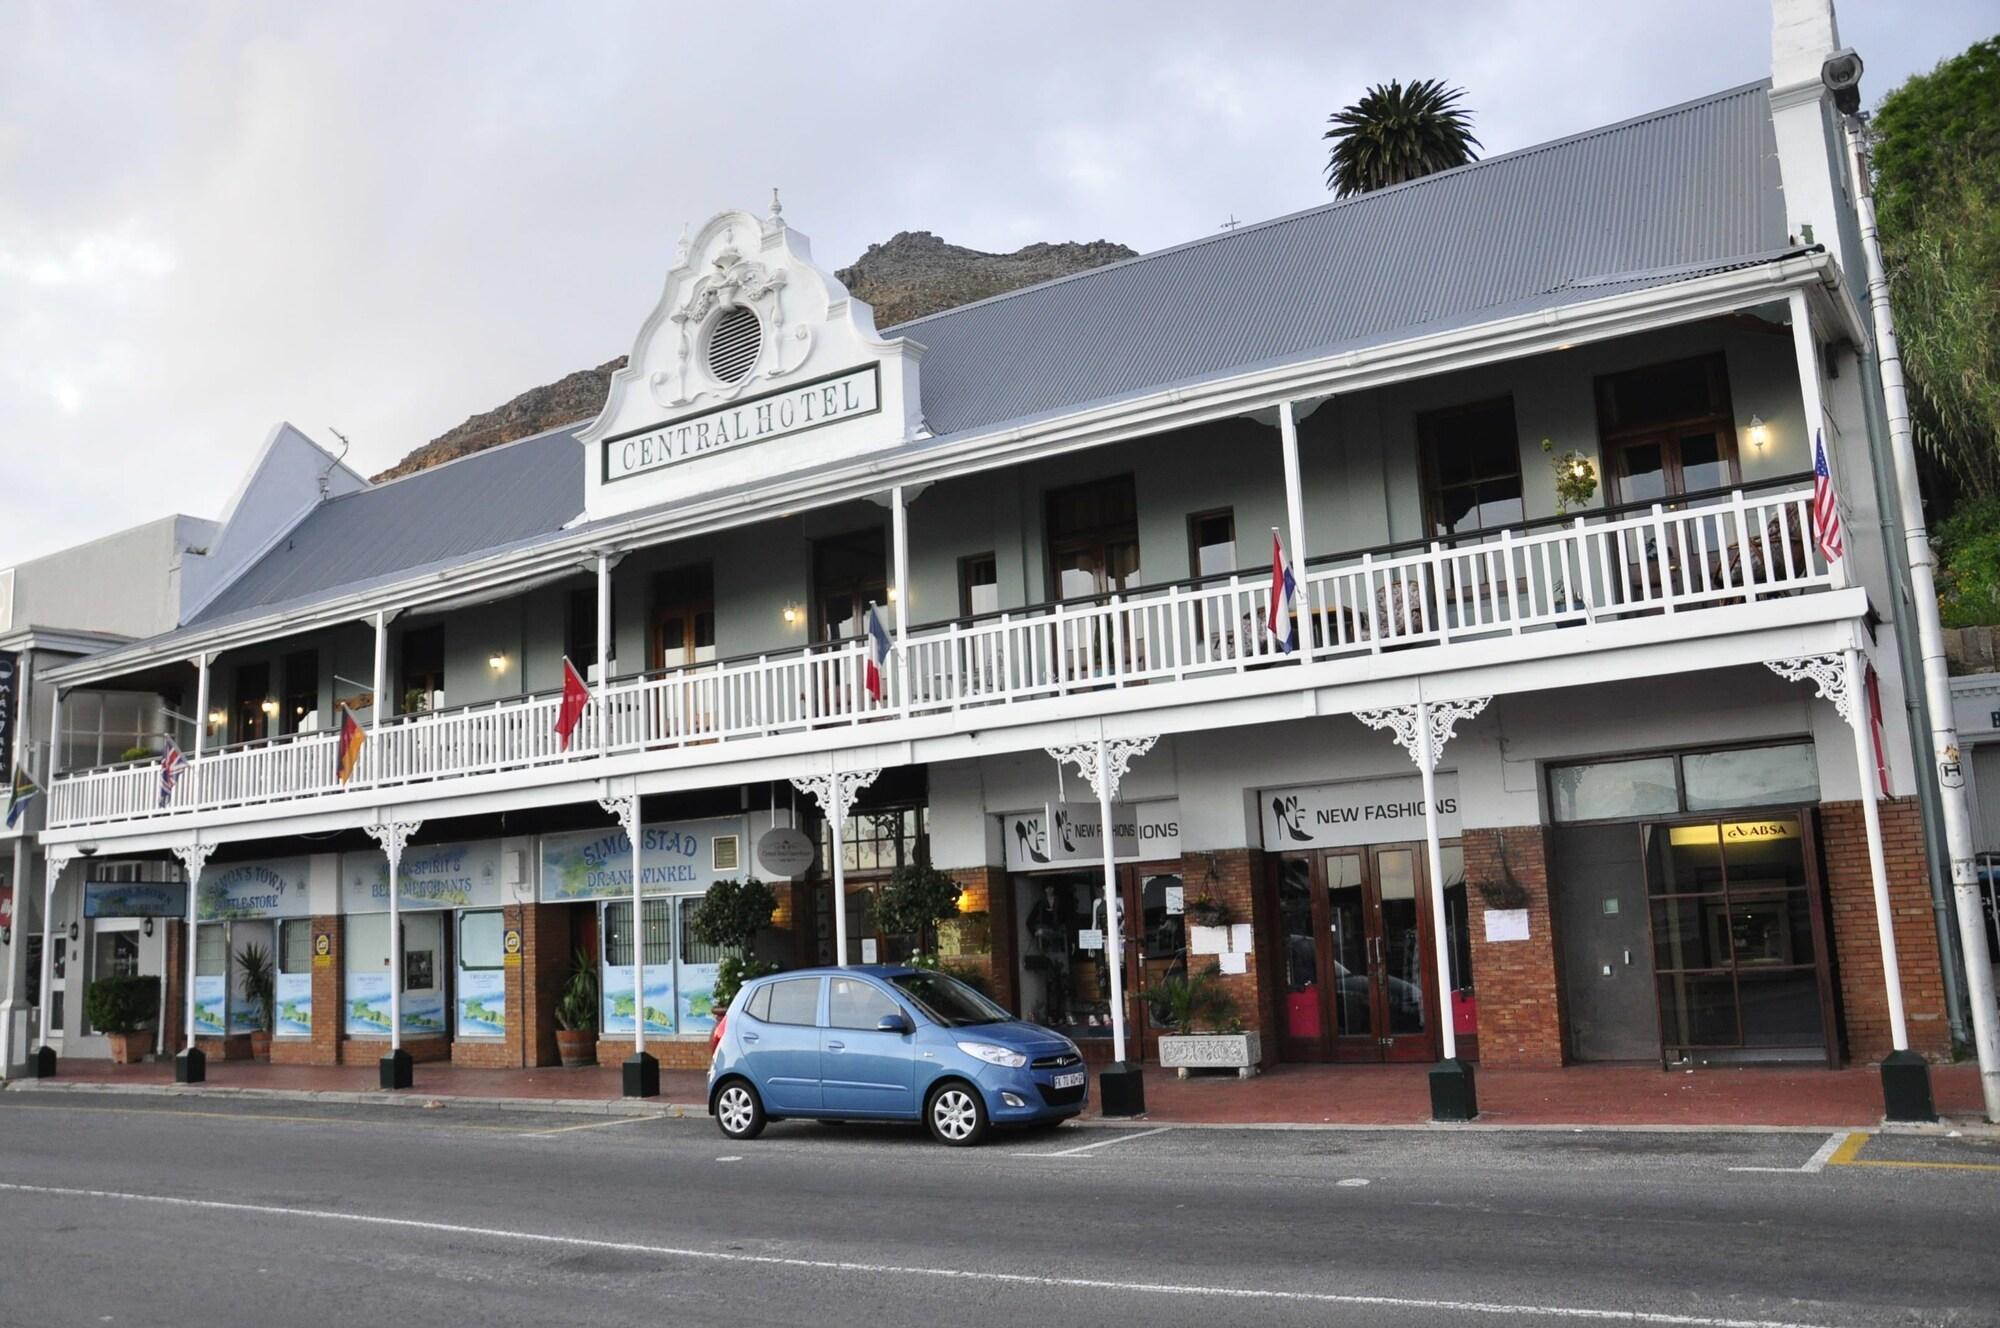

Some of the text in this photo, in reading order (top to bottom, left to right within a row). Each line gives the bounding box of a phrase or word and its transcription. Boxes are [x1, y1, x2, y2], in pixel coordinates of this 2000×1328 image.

[623, 381, 860, 471] CENTRAL HOTEL
[1316, 798, 1457, 825] NEW FASHIONS
[1075, 823, 1135, 838] NEW FHIONS
[1749, 824, 1787, 836] ABSA
[584, 828, 697, 866] SIMOSTAD
[254, 866, 287, 895] TOWN
[249, 894, 279, 909] STORE
